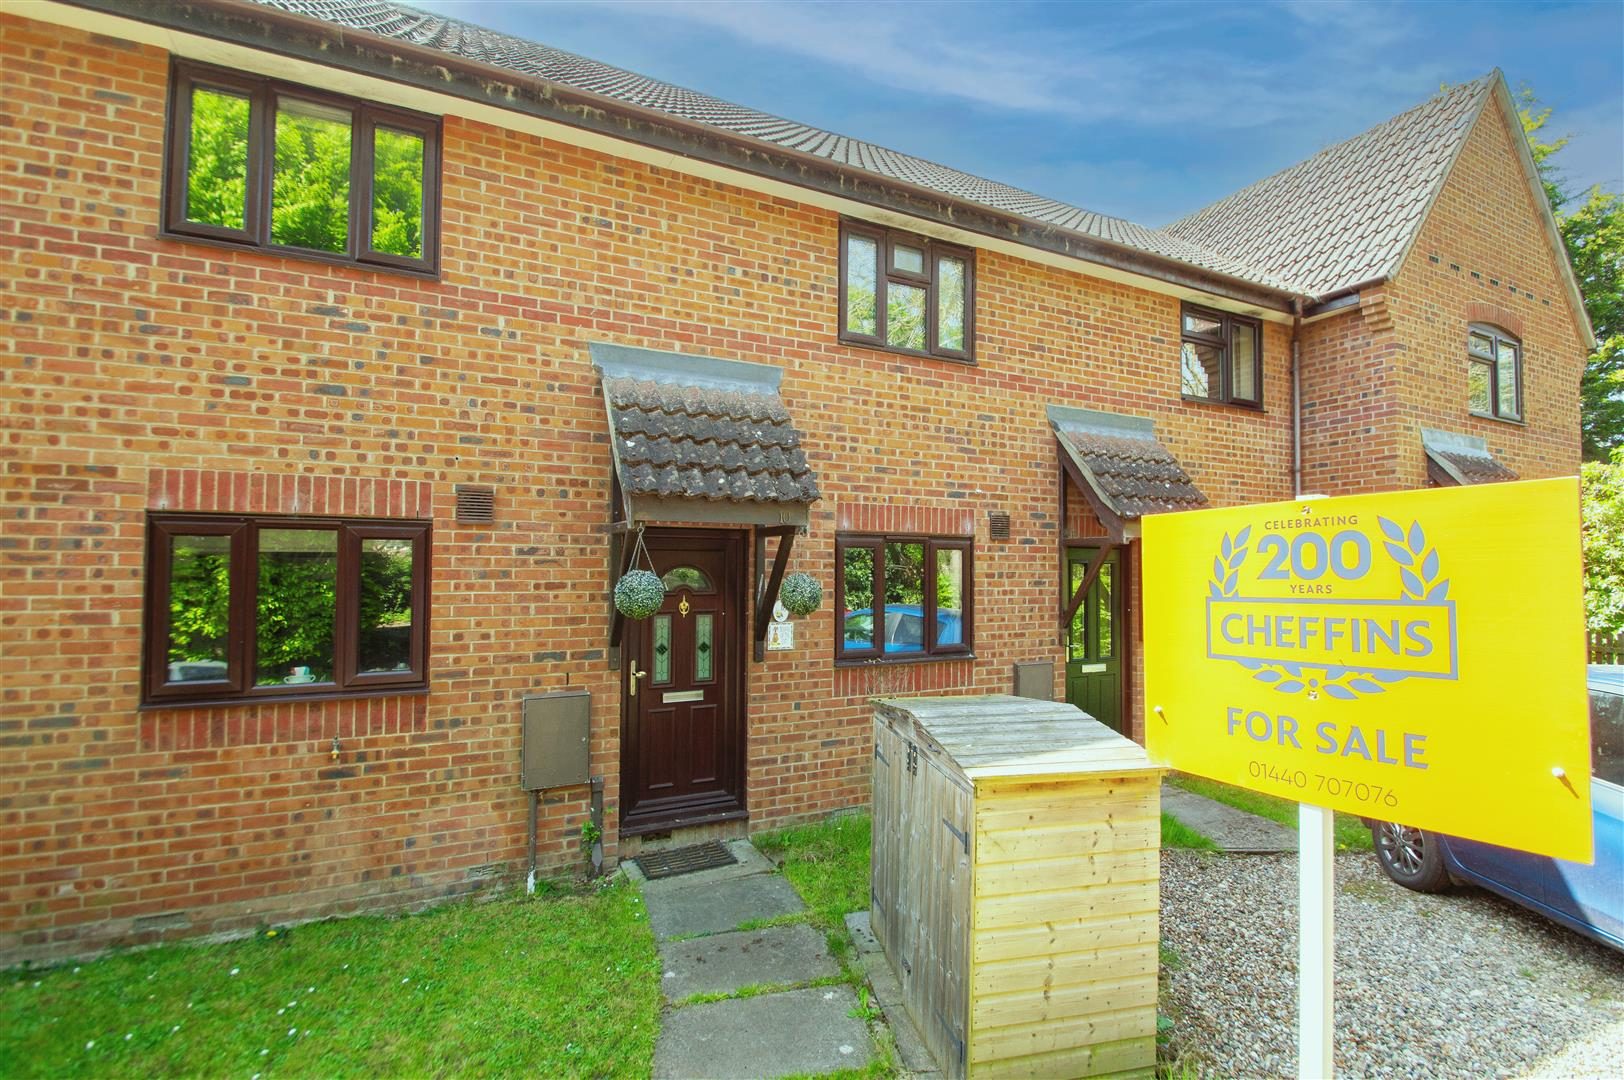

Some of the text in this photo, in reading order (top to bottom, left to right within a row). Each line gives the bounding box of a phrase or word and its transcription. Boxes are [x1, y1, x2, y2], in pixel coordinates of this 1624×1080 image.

[1264, 515, 1359, 530] CELEBRATING
[1257, 530, 1371, 580] 200
[1290, 583, 1333, 594] YEARS
[1221, 613, 1433, 657] CHEFFINS
[1227, 707, 1429, 769] FOR SALE
[1249, 761, 1398, 807] 01440 707076
